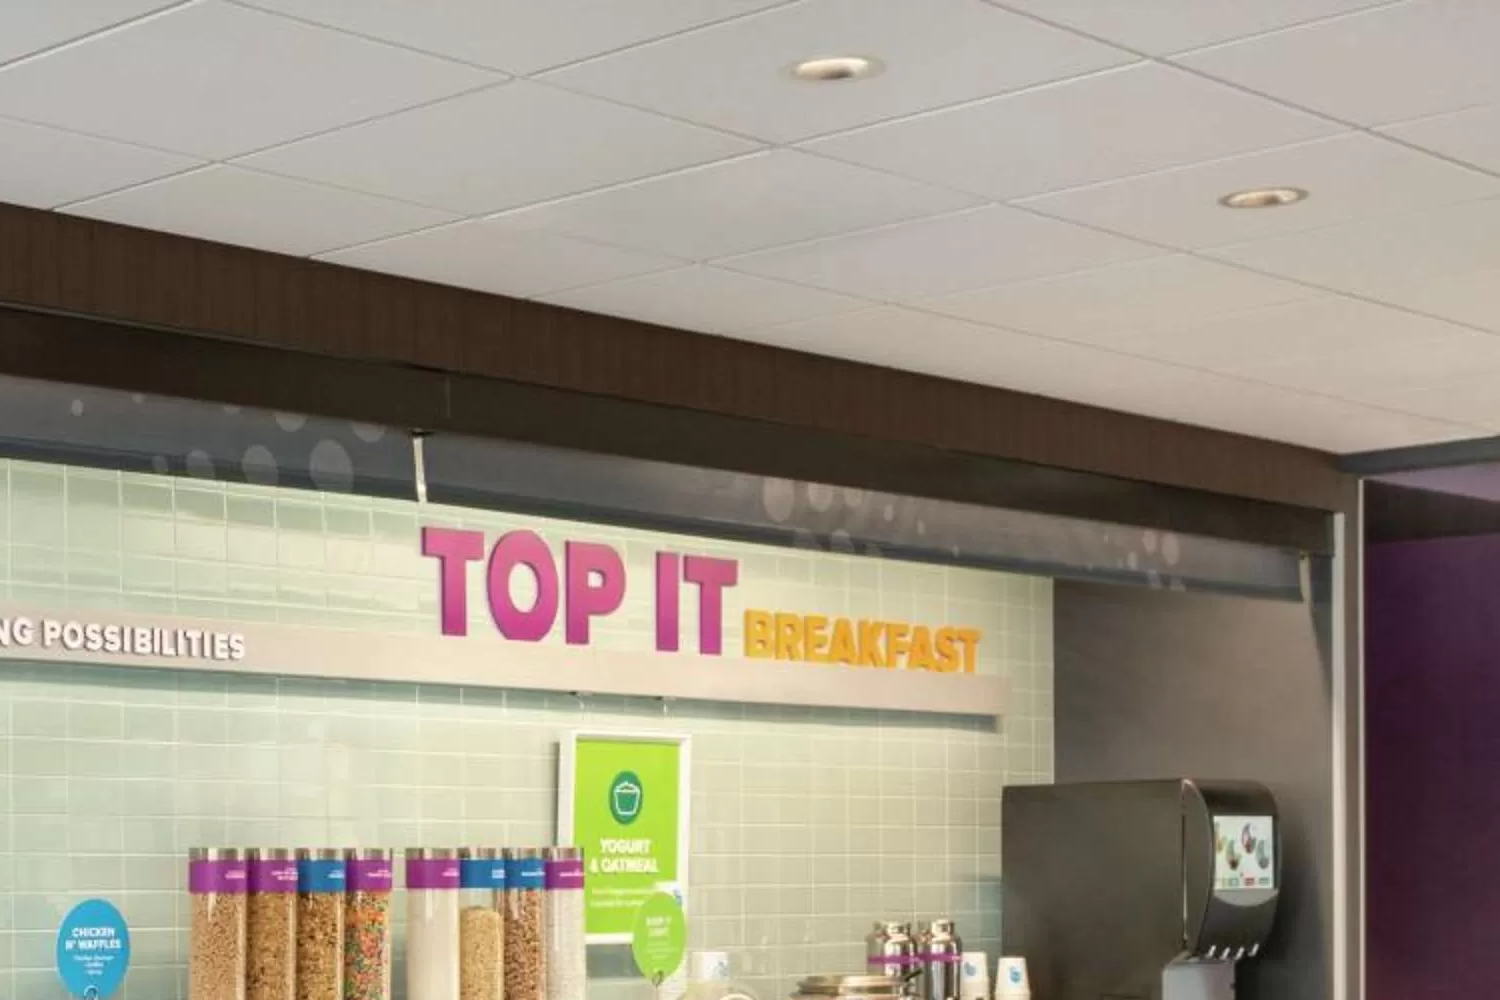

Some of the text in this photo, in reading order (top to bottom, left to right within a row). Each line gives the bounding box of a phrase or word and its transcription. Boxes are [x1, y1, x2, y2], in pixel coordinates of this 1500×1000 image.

[421, 526, 738, 656] TOP IT
[42, 619, 246, 660] POSSIBILITIES
[744, 609, 982, 673] BREAKFAST
[601, 838, 652, 855] YOGURT
[589, 857, 599, 873] &
[601, 857, 660, 873] OATMEAL
[71, 927, 115, 937] CHICKEN
[78, 938, 121, 949] WAFFLES
